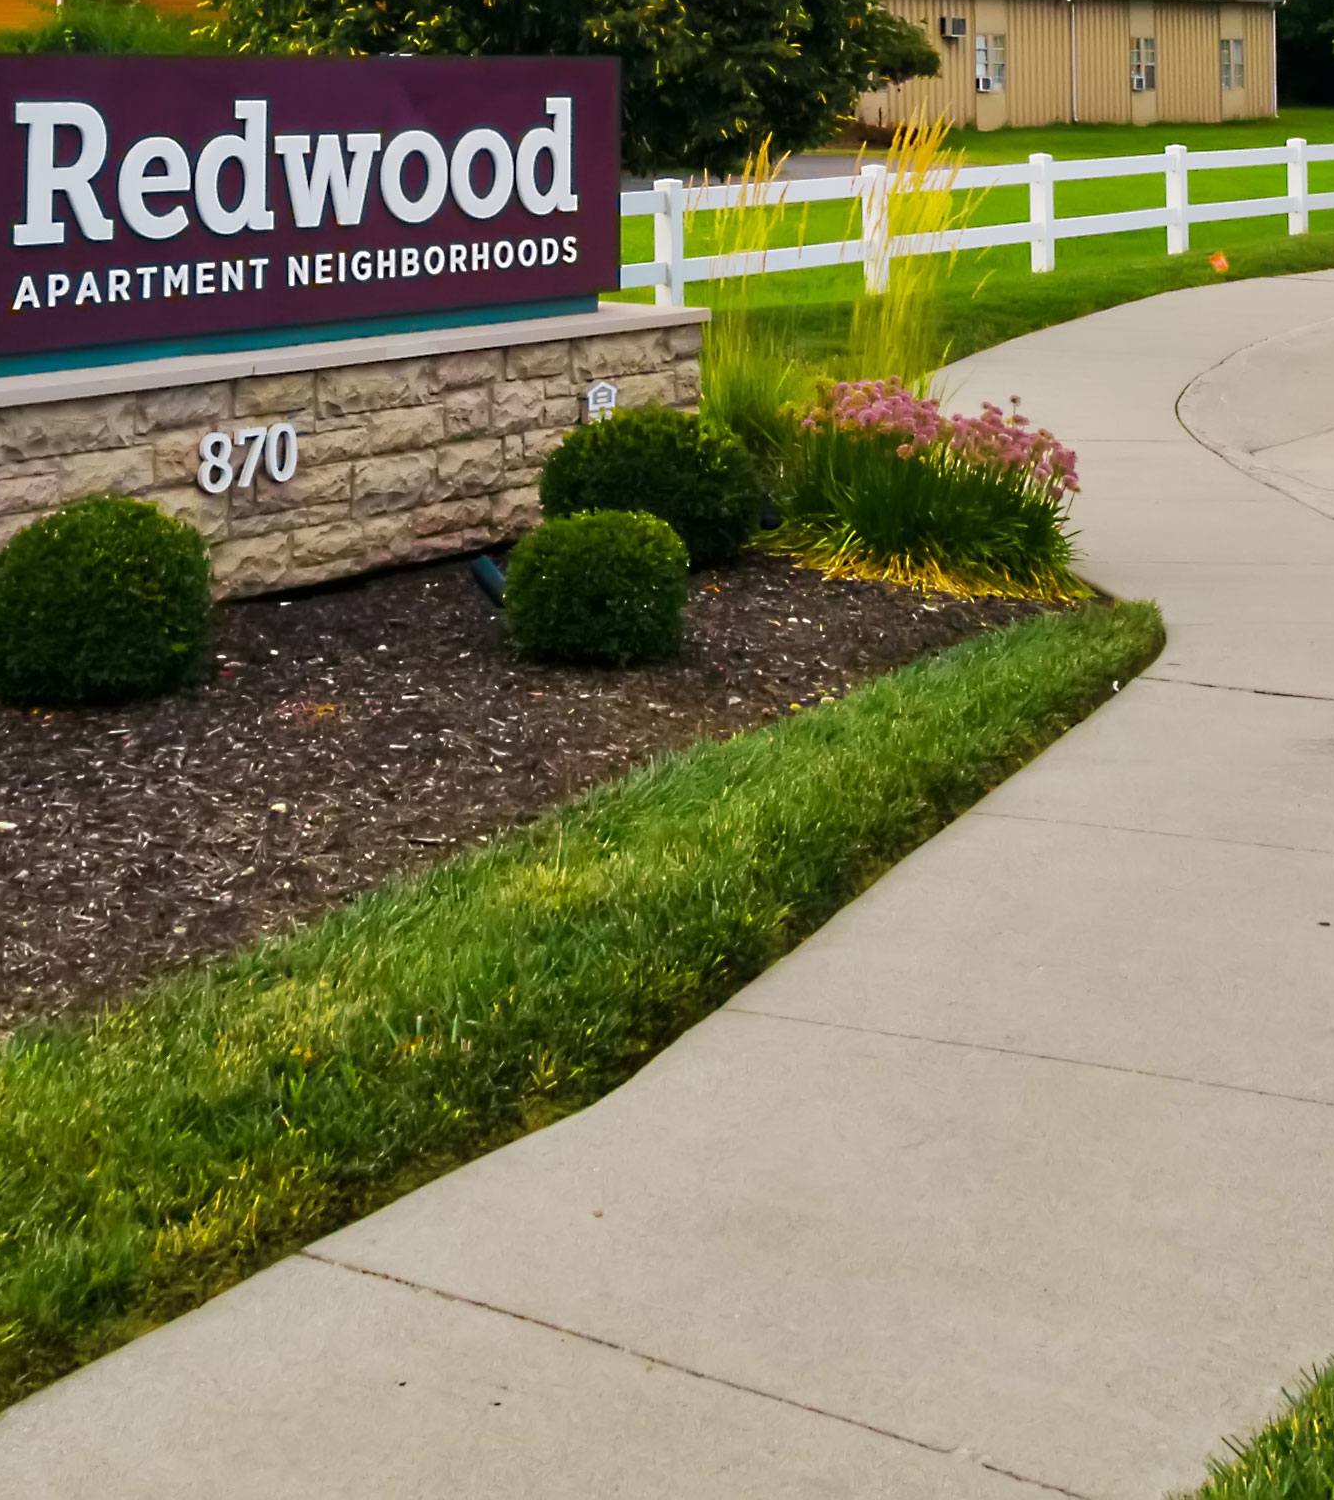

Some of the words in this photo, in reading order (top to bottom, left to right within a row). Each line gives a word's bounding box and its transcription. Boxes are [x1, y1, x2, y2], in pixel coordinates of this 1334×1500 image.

[12, 96, 579, 247] Redwood
[12, 257, 270, 311] APARTMENT
[287, 235, 579, 287] NEIGHBORHOODS
[197, 422, 299, 494] 870
